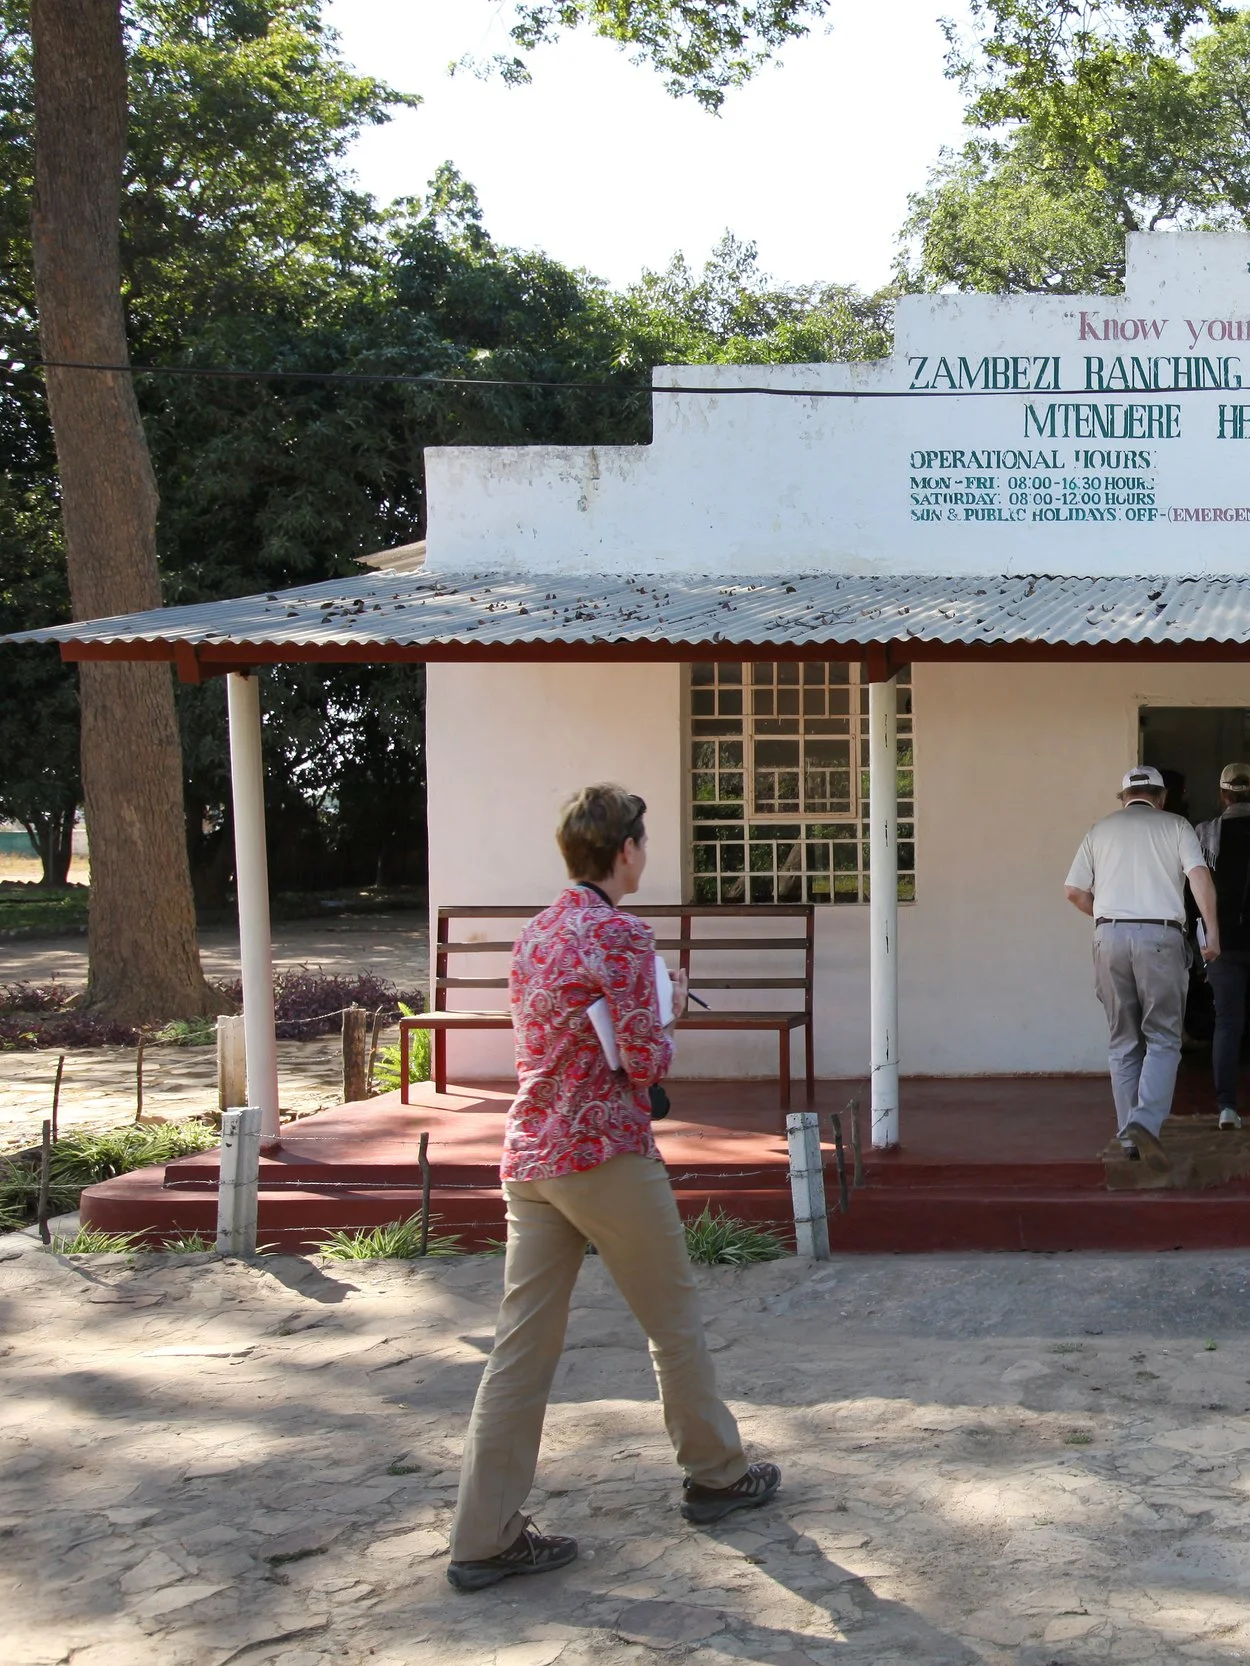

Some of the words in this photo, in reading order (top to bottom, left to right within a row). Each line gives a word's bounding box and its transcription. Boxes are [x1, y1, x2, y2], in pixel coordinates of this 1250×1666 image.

[908, 356, 1062, 390] ZAMBEZI
[1083, 356, 1242, 391] RANCHING
[1023, 403, 1182, 438] MTENDERE
[910, 449, 1065, 469] OPERATIONAL
[1104, 476, 1156, 490] HOURS
[1104, 492, 1156, 506] HOURS
[910, 508, 943, 522] SUN
[947, 508, 958, 521] &
[964, 508, 1027, 522] PUBLIC
